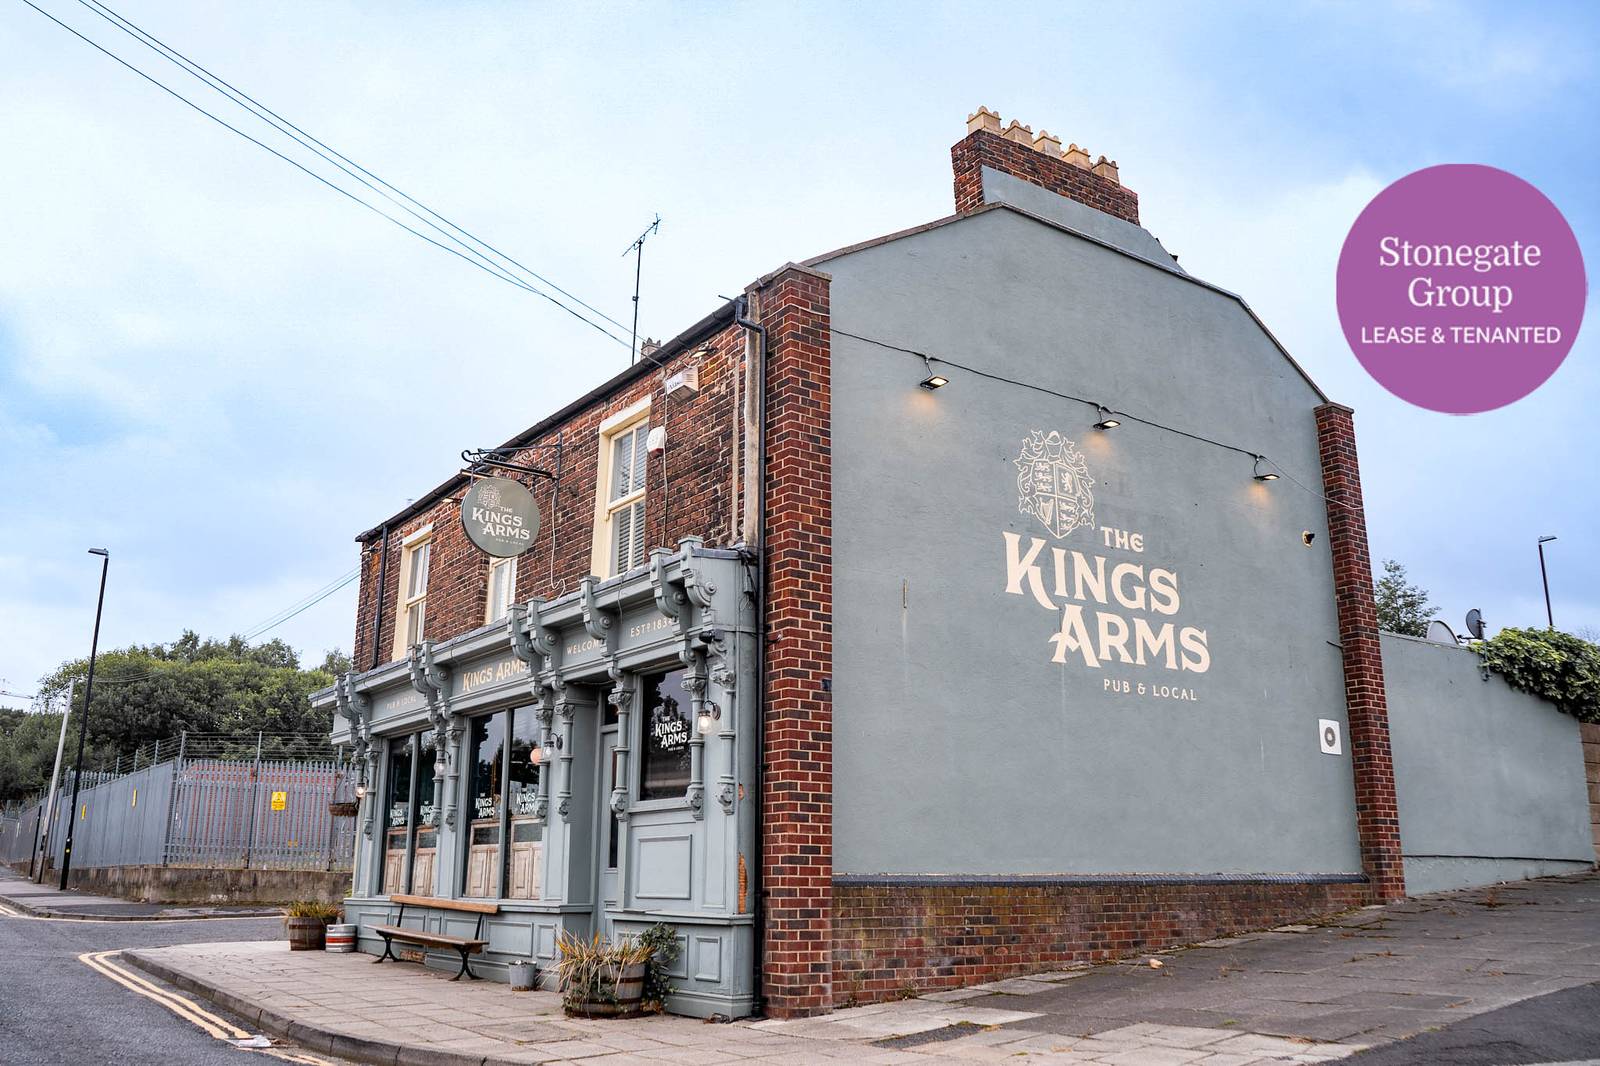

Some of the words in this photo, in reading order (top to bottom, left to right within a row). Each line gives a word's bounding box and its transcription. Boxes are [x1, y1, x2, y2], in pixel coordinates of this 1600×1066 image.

[472, 507, 523, 527] KINGS
[482, 522, 530, 540] ARMS
[1100, 526, 1144, 552] THE
[1002, 531, 1180, 615] KINGS
[1048, 603, 1211, 673] ARMS
[566, 639, 600, 655] WELCOM
[463, 667, 493, 692] KINGS
[496, 658, 527, 682] ARMS
[1103, 678, 1131, 694] PUB
[1137, 682, 1147, 695] &
[1152, 684, 1198, 701] LOCAL
[655, 721, 682, 737] KINGS
[660, 732, 687, 748] ARMS
[475, 797, 493, 810] KINGS
[516, 793, 536, 806] KINGS
[478, 807, 495, 818] ARMS
[520, 802, 539, 815] ARM
